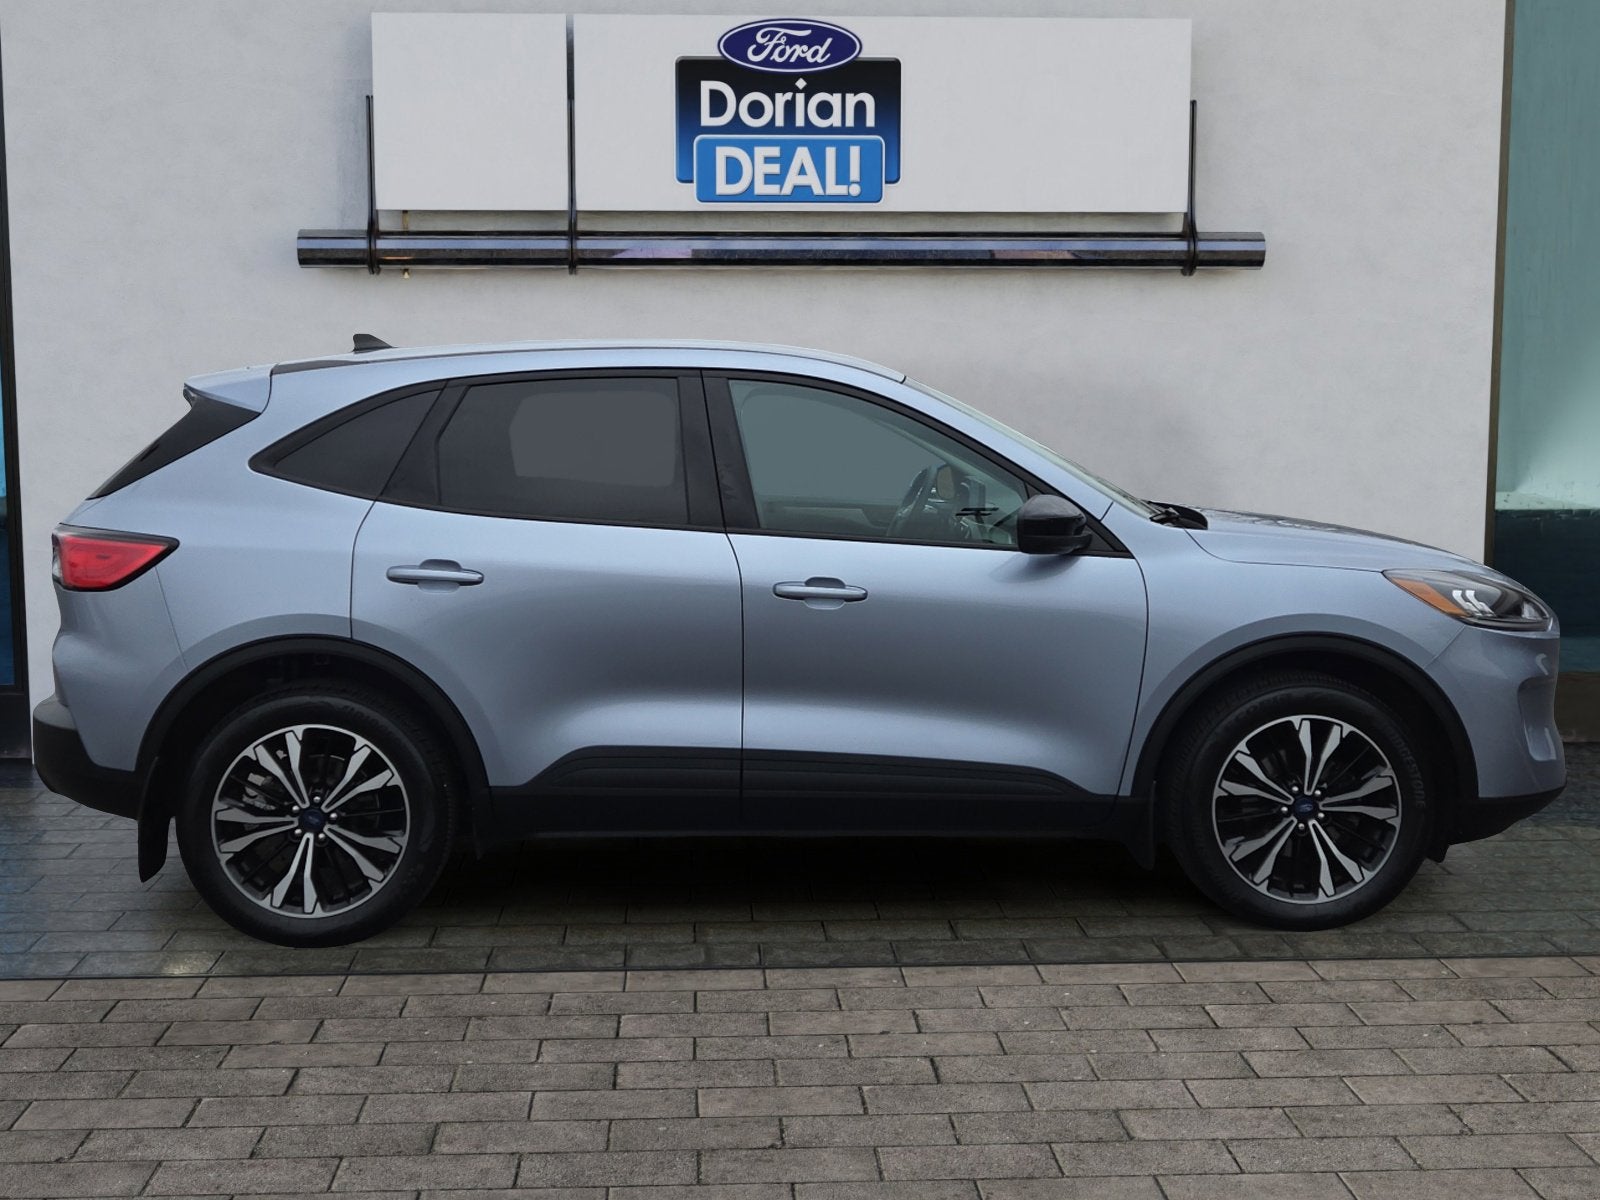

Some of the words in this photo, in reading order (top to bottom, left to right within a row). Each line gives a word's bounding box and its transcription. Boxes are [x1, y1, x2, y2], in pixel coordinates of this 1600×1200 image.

[747, 27, 832, 63] Ford
[700, 78, 875, 128] Dorian
[715, 145, 861, 197] DEAL!
